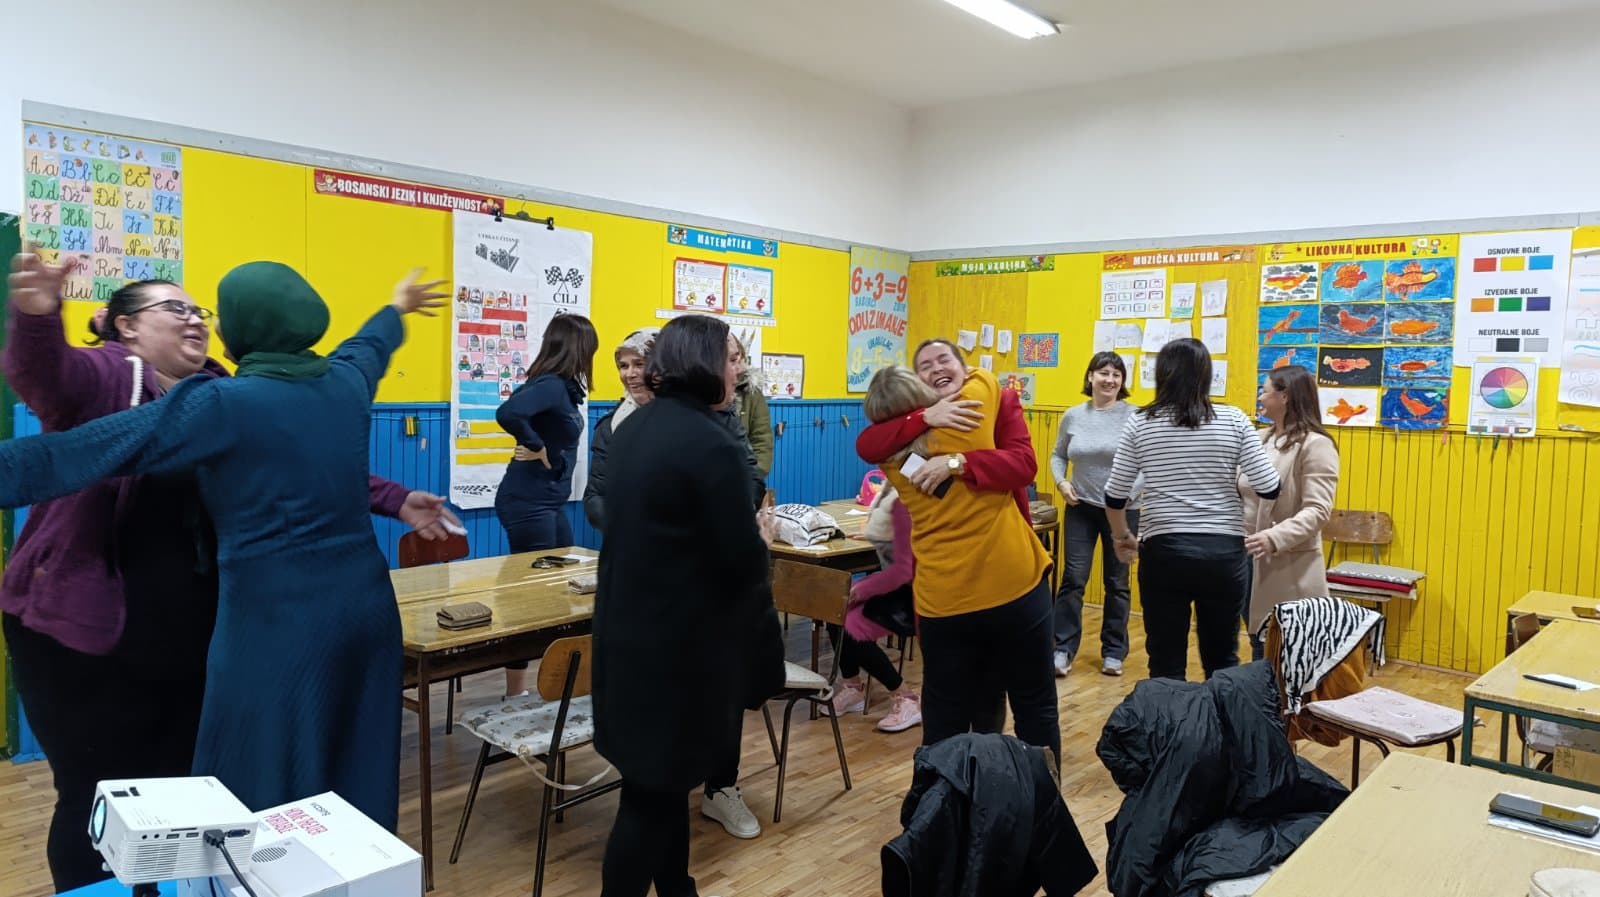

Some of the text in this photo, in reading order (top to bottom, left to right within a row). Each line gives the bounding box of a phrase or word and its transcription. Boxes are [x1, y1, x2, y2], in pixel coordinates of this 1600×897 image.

[337, 178, 482, 212] BOSANSKI JEZIK I KNJIŽEVNOST
[697, 233, 752, 250] MATEMATIKA
[1305, 242, 1407, 257] LIKOVNA KULTURA
[1487, 246, 1541, 256] OSNOVNE BOJE
[1133, 251, 1220, 266] MUZIČKA KULTURA
[961, 262, 985, 272] MOJA
[1484, 287, 1539, 296] IZVEDENE BOJE
[1478, 328, 1540, 336] NEUTRALNE BOJE
